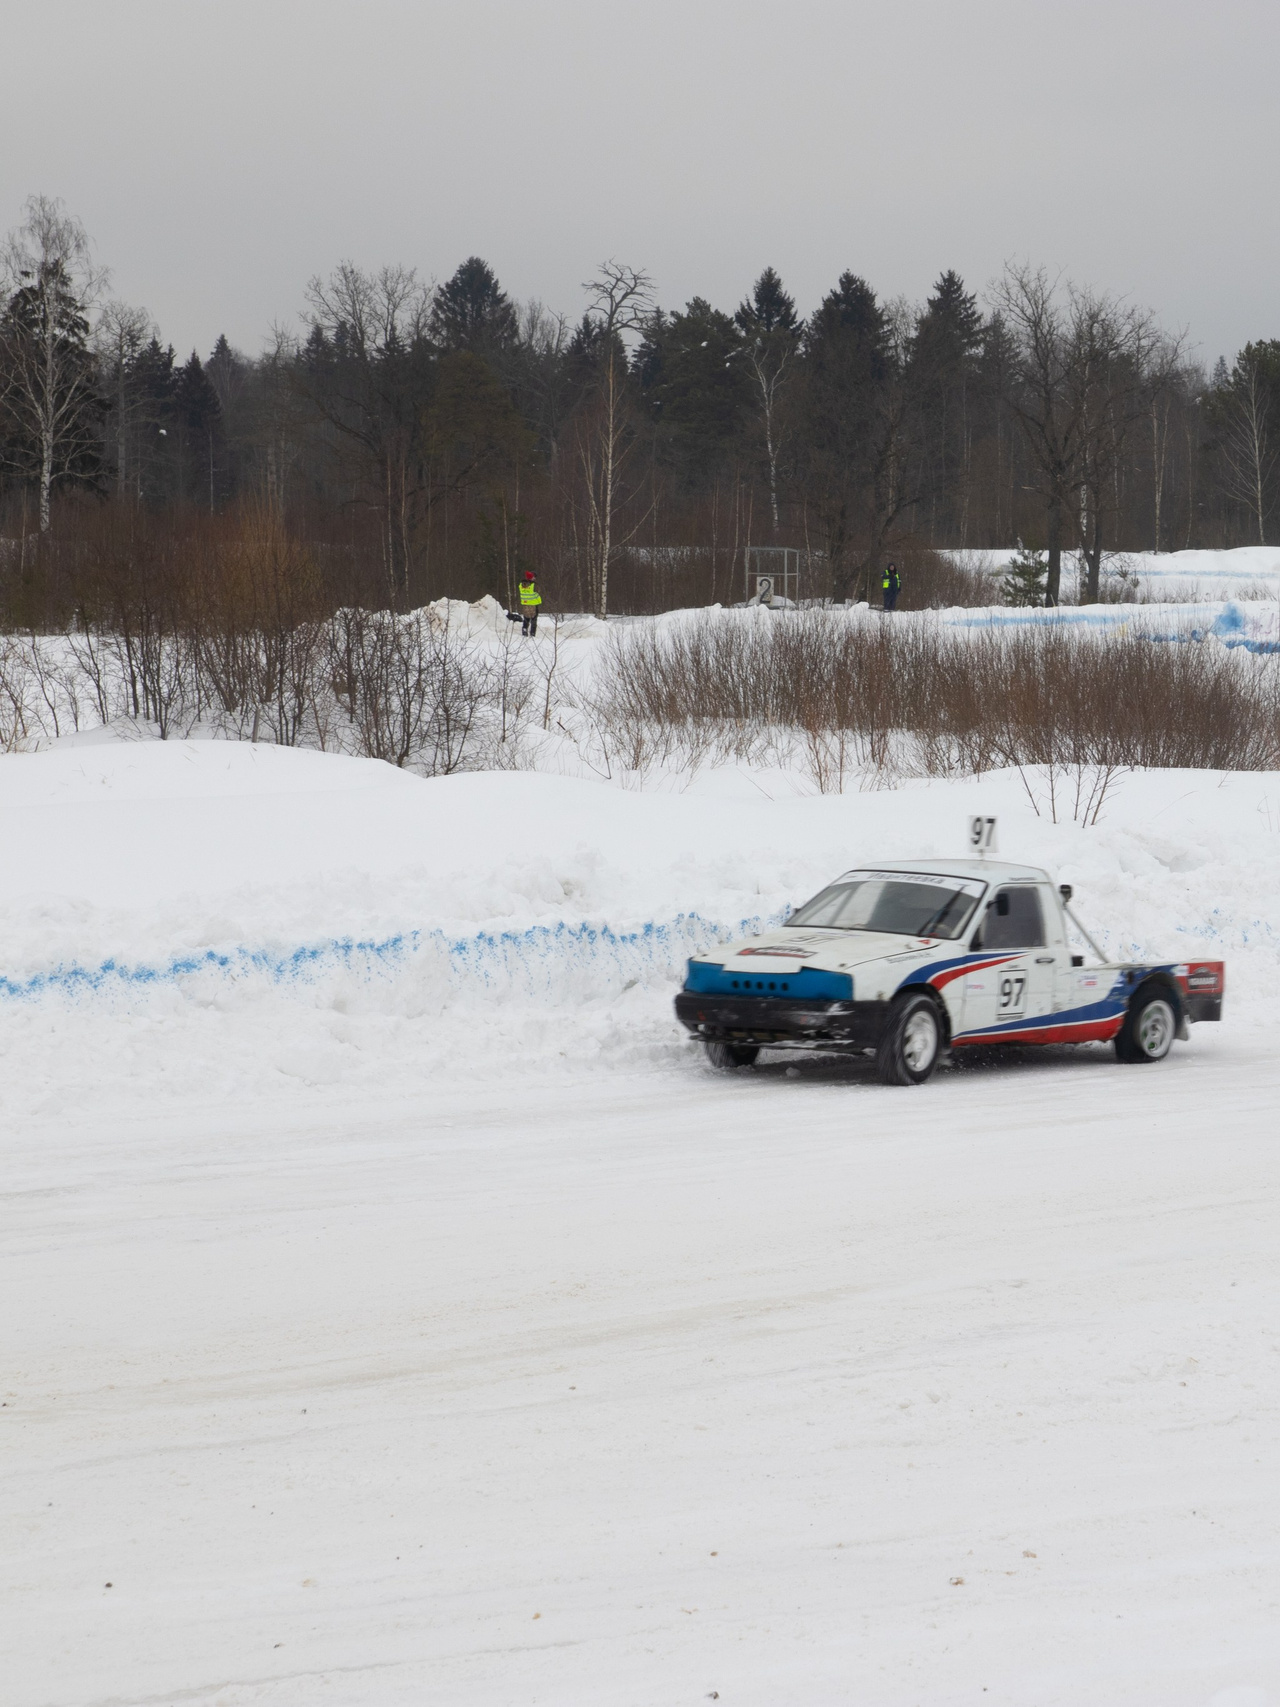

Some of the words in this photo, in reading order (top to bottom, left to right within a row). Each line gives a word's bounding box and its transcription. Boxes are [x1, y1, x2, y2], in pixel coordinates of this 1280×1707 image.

[759, 578, 771, 603] 2
[971, 817, 996, 847] 97
[1000, 978, 1026, 1007] 97
